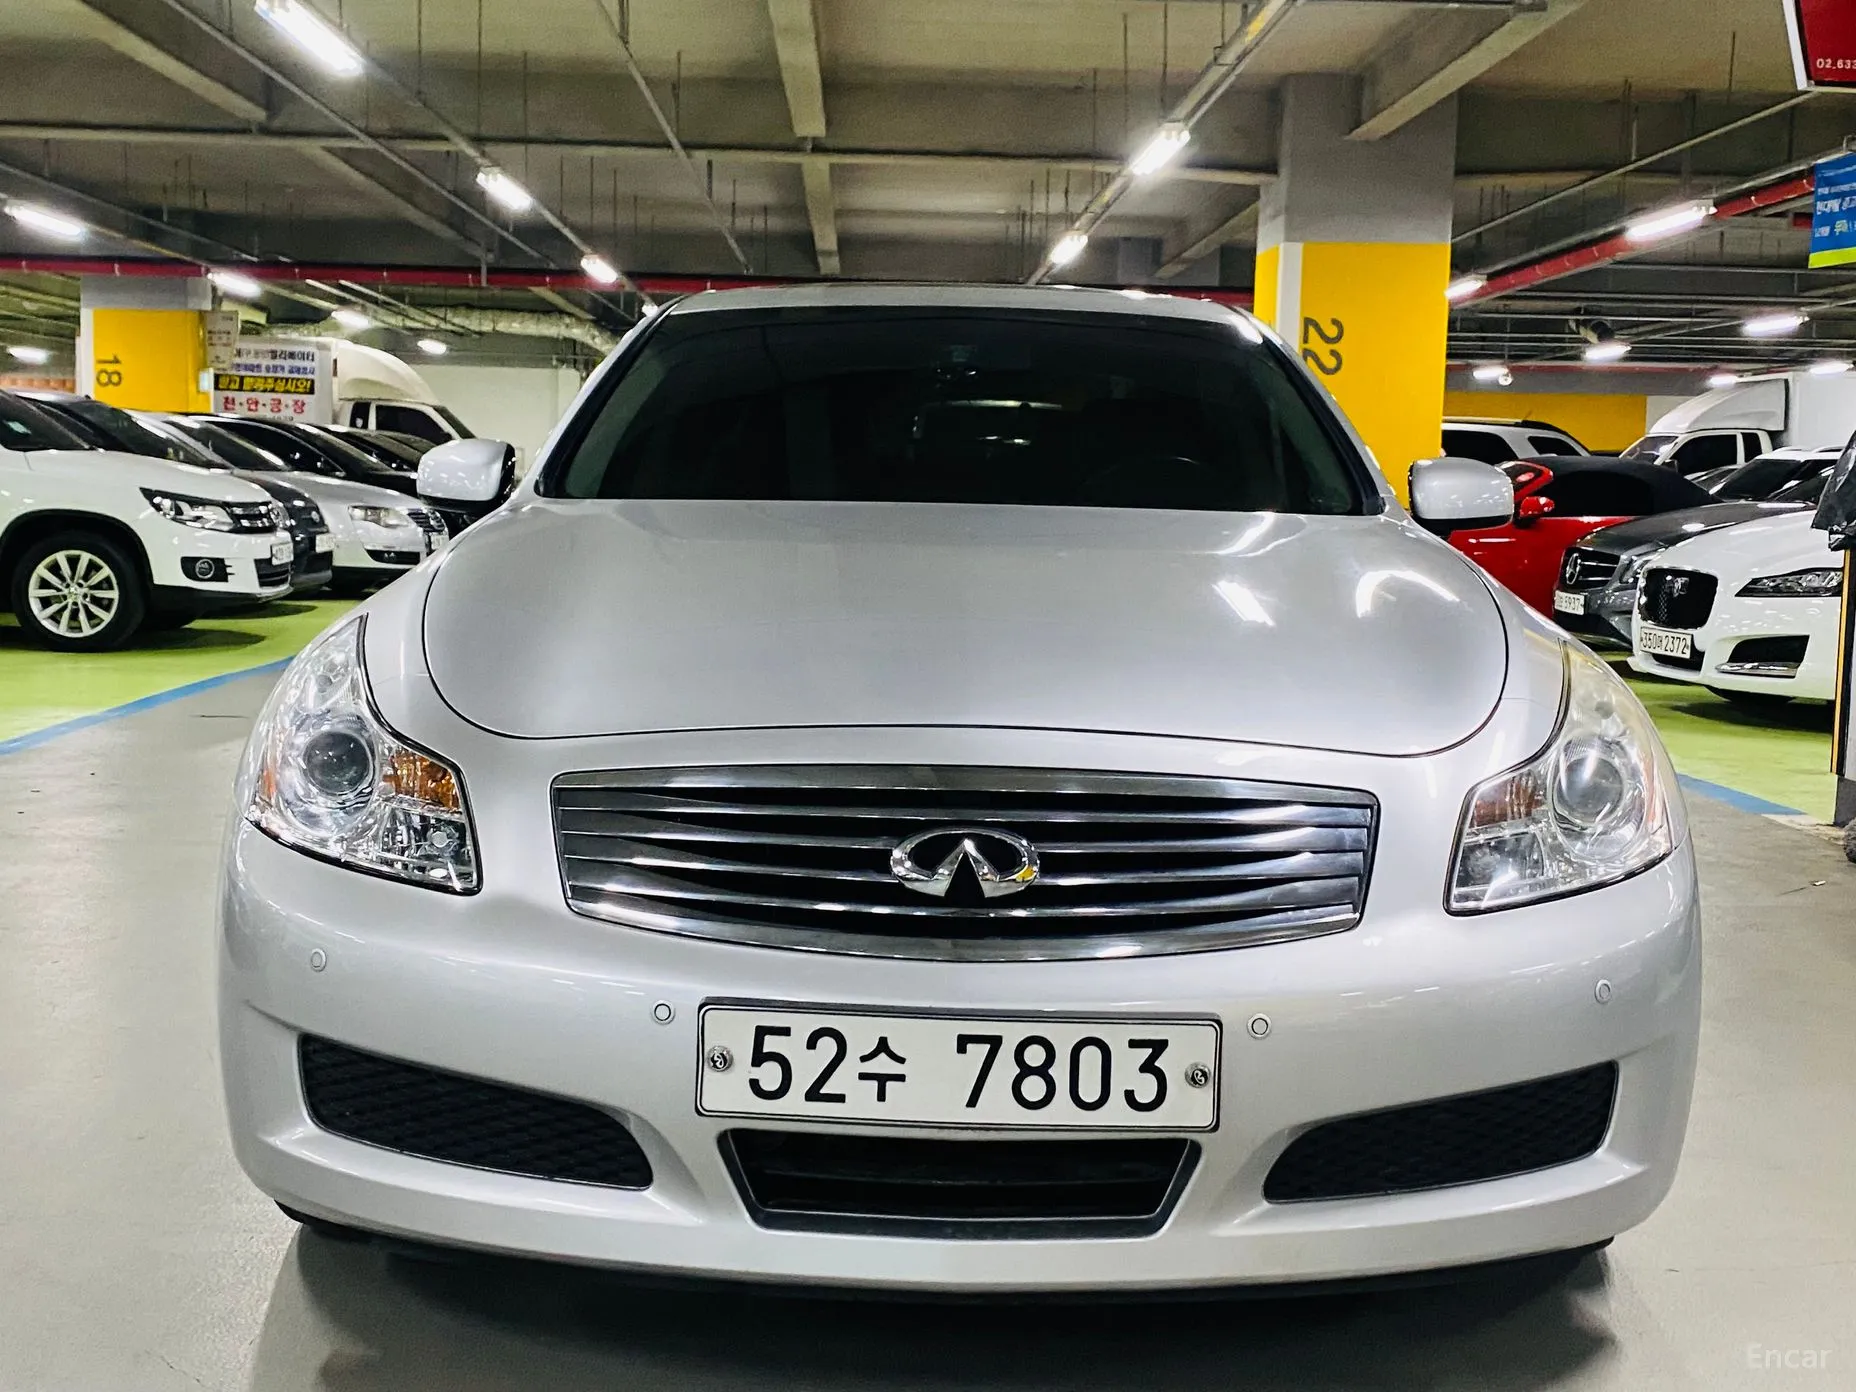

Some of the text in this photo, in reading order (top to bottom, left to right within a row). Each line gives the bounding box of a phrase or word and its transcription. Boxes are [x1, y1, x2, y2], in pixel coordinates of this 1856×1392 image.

[1302, 317, 1344, 375] 22
[96, 353, 122, 387] 18
[1664, 635, 1687, 655] 2372
[748, 1025, 1169, 1112] 52수 7803
